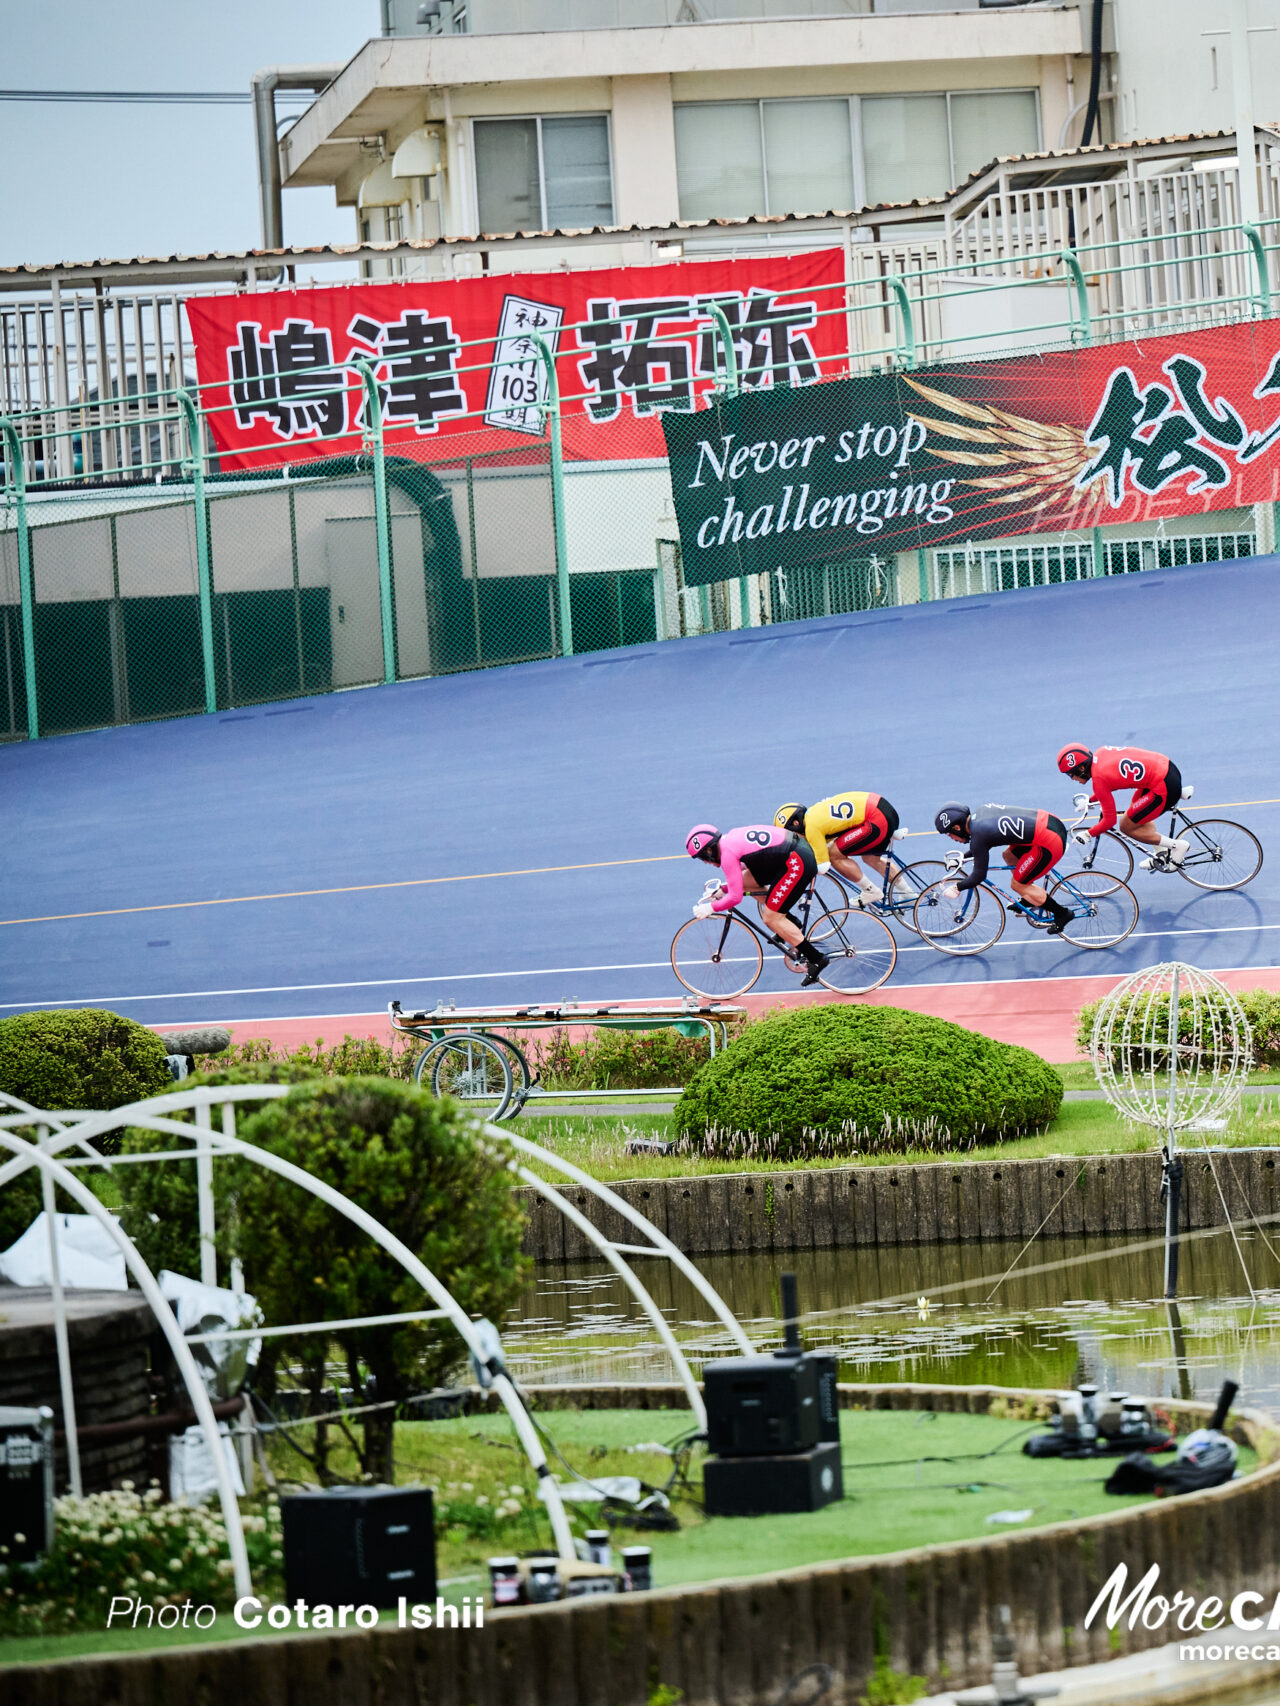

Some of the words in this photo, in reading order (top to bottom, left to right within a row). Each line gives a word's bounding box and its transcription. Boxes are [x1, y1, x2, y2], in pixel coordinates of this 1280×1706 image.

[226, 308, 467, 440] 嶋津
[688, 433, 826, 489] Never
[834, 416, 927, 468] stop
[696, 471, 957, 549] challenging
[1066, 753, 1076, 767] 3
[1119, 757, 1146, 782] 3
[777, 812, 787, 825] 5
[829, 801, 854, 820] 5
[940, 812, 951, 828] 2
[998, 815, 1025, 840] 2
[692, 837, 701, 851] 8
[745, 829, 772, 847] 8
